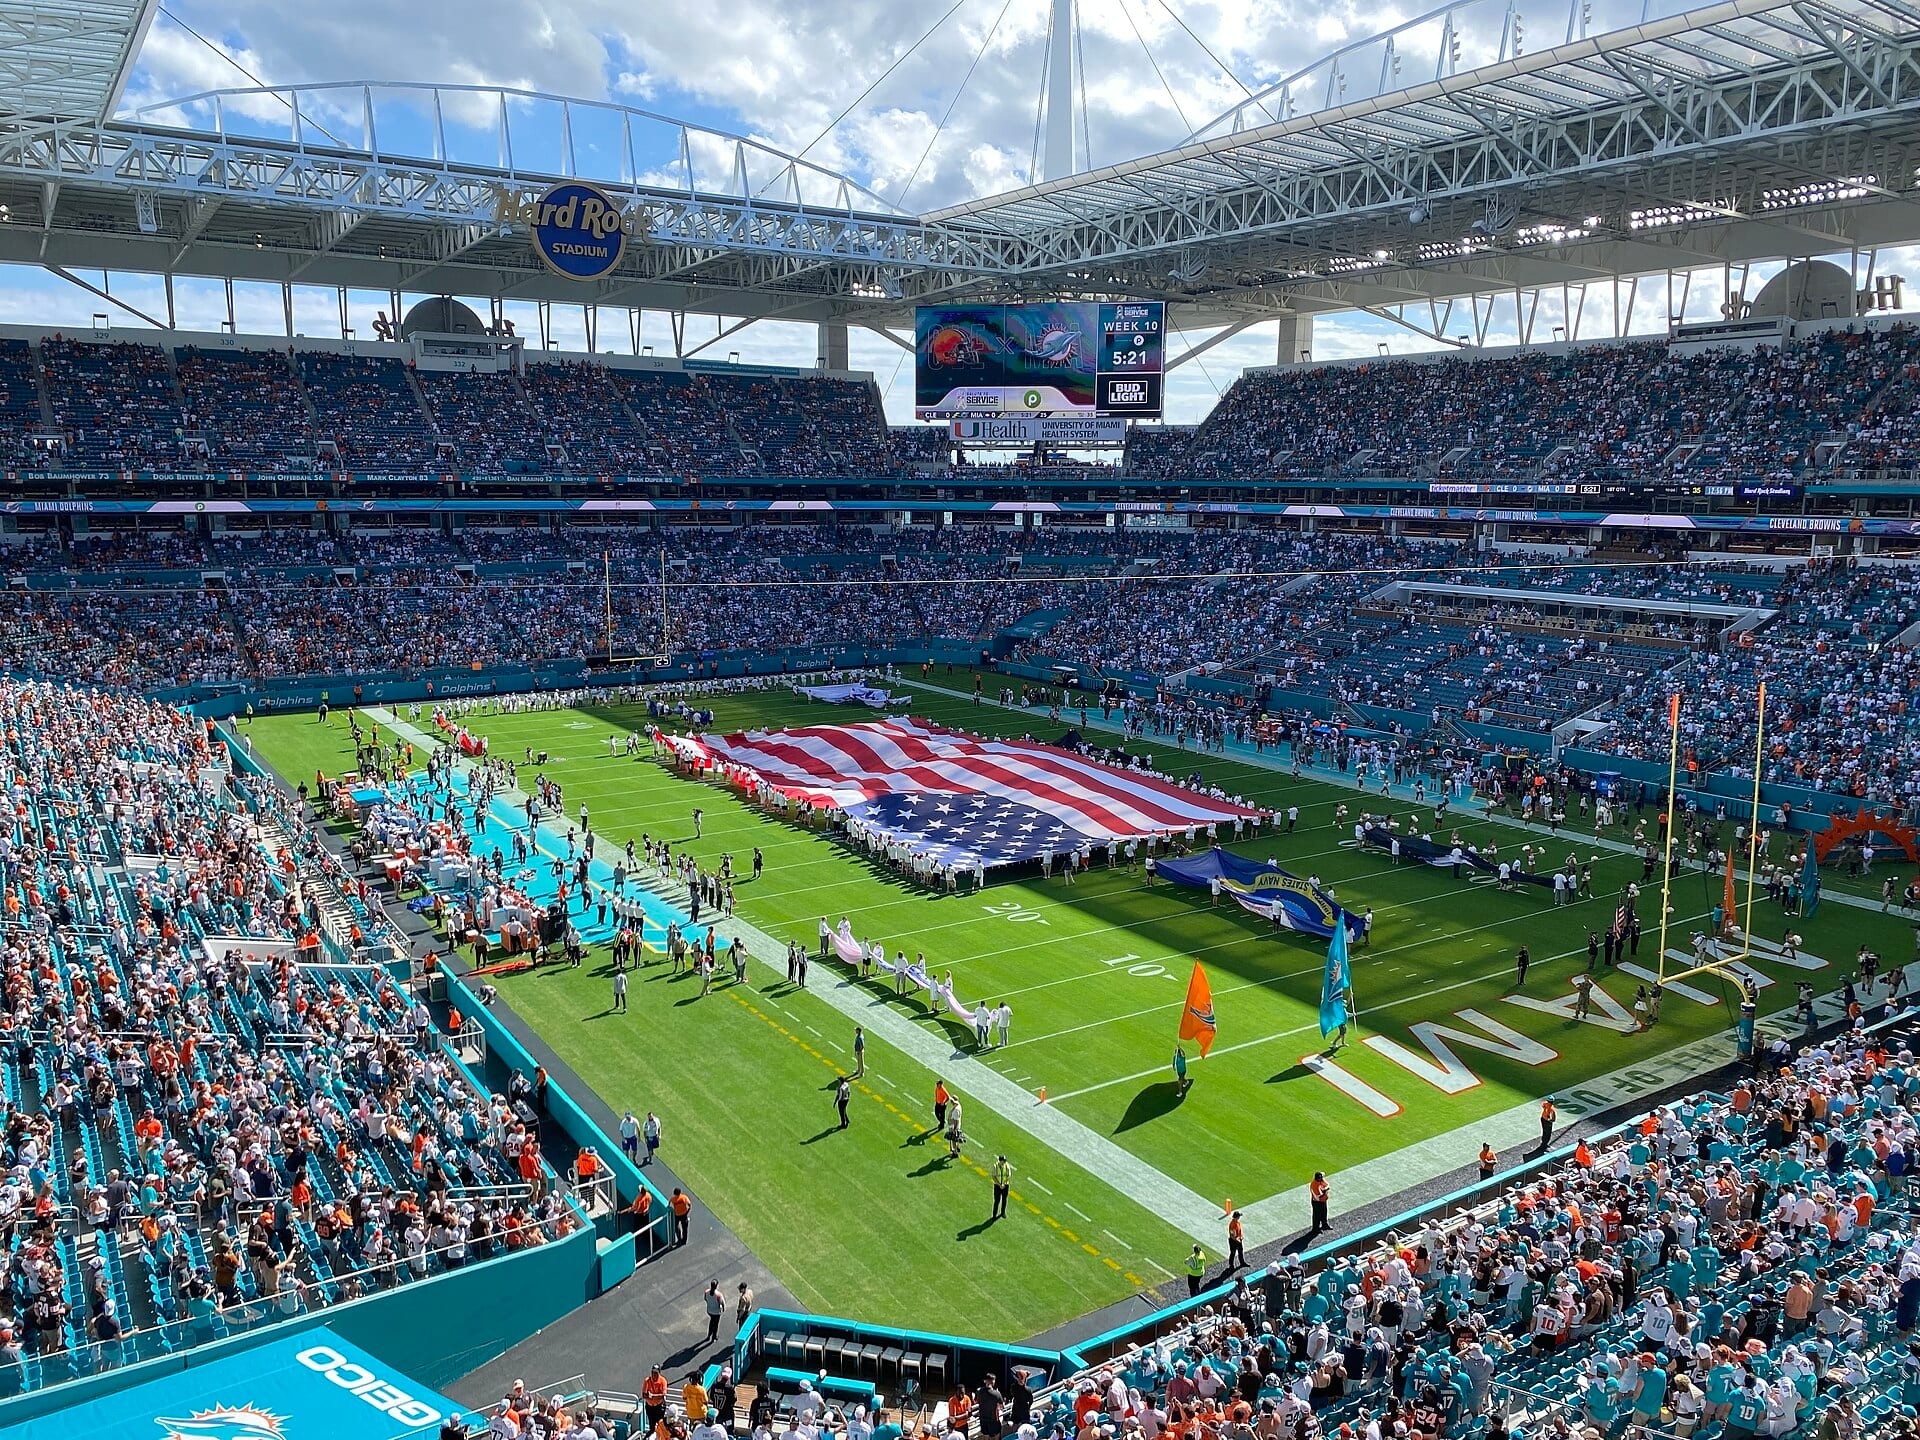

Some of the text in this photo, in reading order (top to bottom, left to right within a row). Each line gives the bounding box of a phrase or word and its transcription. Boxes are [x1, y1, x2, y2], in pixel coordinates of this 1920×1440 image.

[496, 189, 653, 243] Hard Rock
[552, 242, 608, 258] STADIUM
[1104, 322, 1158, 332] WEEK 10
[1112, 351, 1146, 364] 5:21
[1115, 384, 1140, 392] BUD
[966, 396, 998, 404] SERVICE
[1110, 392, 1145, 401] LIGHT
[35, 502, 94, 511] MIAMI DOLPHINS
[1769, 518, 1841, 531] CLEVELAND BROWNS
[441, 682, 490, 694] Dolphins
[1258, 876, 1280, 886] NAVY
[1282, 878, 1309, 892] STATES
[982, 902, 1041, 922] 20
[1100, 952, 1166, 977] 10
[1301, 925, 1833, 1118] MIAMI
[1609, 1070, 1664, 1094] OF
[1552, 1089, 1612, 1115] US
[508, 1142, 519, 1153] 24
[1908, 1185, 1920, 1197] 13
[1328, 1282, 1336, 1292] 10
[1541, 1317, 1555, 1331] 10
[1653, 1318, 1665, 1328] 10
[295, 1346, 442, 1427] GEICO
[1443, 1396, 1454, 1408] 17
[1607, 1395, 1616, 1406] 17
[1416, 1408, 1438, 1428] 24
[1740, 1405, 1755, 1420] 10
